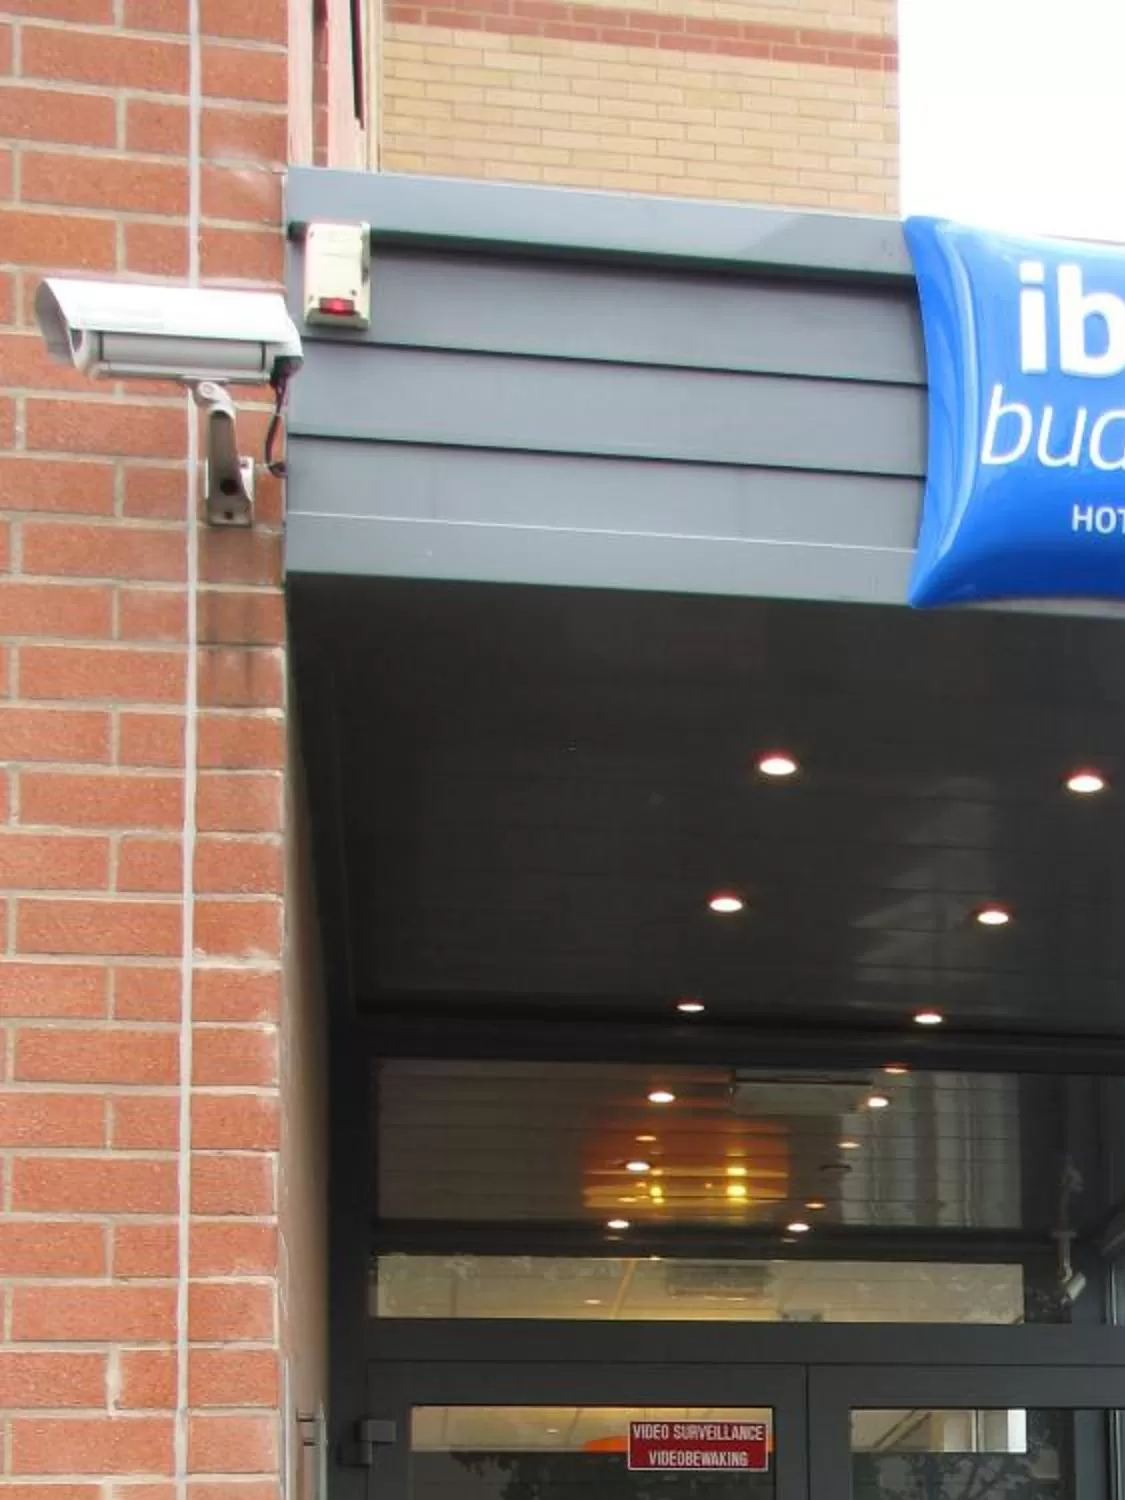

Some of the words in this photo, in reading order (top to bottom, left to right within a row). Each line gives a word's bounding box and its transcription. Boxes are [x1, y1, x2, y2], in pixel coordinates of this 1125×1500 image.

[632, 1423, 670, 1440] VIDEO
[673, 1424, 765, 1441] SURVEILLANCE
[648, 1450, 749, 1467] VIDEOBEWAKING
